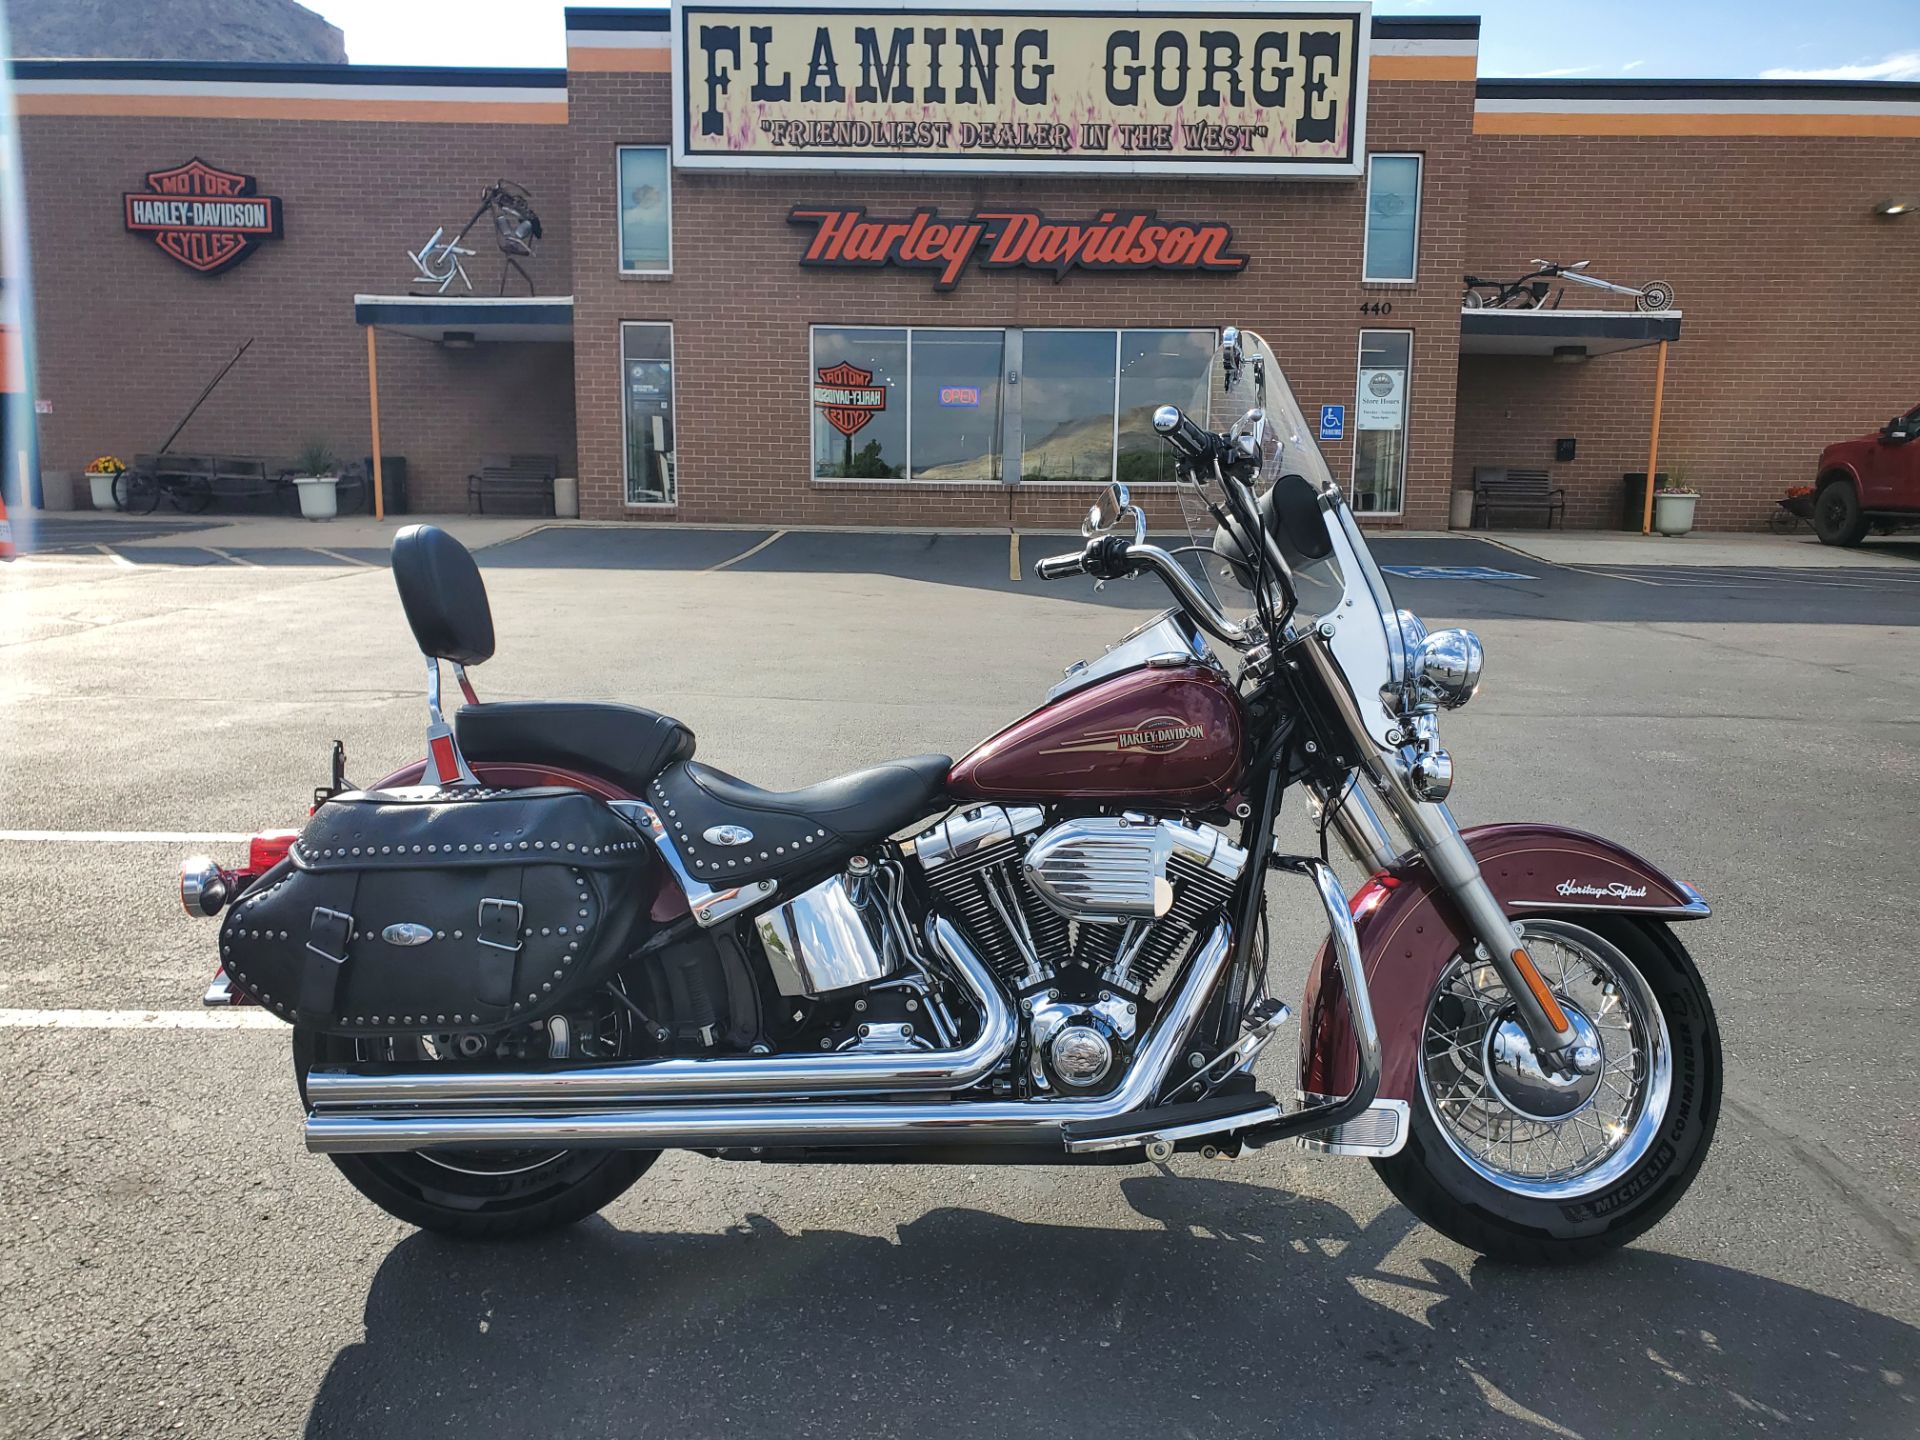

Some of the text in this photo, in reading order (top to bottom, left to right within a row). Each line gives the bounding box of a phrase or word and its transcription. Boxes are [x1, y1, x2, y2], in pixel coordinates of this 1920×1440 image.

[700, 25, 1340, 143] FLAMING GORGE
[761, 119, 1268, 152] "FRIENDLIEST DEALER IN THE WEST"
[162, 168, 232, 195] MOTOR
[133, 201, 265, 227] HARLEY-DAVIDSON
[167, 232, 235, 264] CYCLES
[792, 210, 1243, 284] Harley-Davidson
[1360, 302, 1392, 315] 440
[941, 388, 977, 403] OPEN
[1556, 879, 1647, 900] Heritage Softail
[1595, 1023, 1695, 1214] MICHELIN COMMANDER
